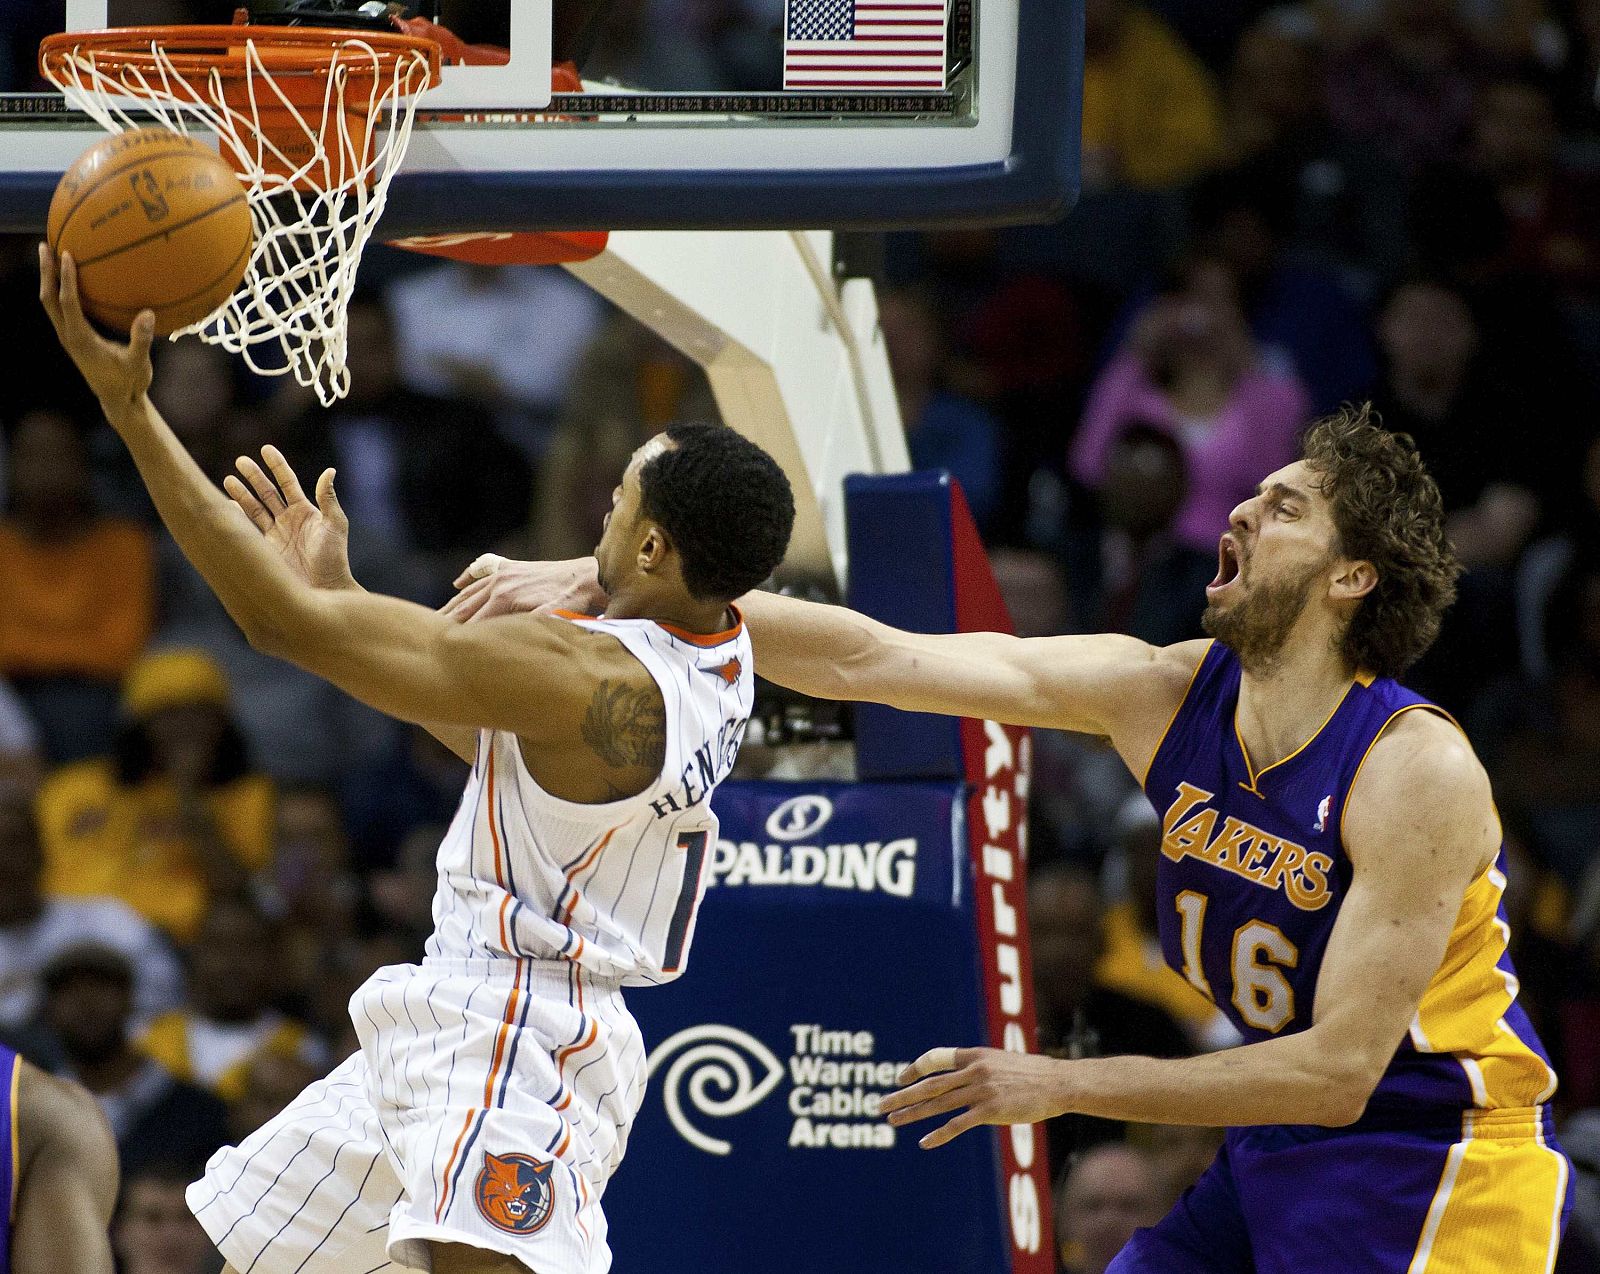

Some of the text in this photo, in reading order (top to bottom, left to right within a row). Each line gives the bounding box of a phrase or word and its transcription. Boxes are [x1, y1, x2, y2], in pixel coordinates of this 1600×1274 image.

[1160, 781, 1334, 911] LAKERS
[706, 837, 918, 898] PALDING
[1175, 889, 1299, 1034] 16
[789, 1023, 875, 1055] Time
[789, 1055, 910, 1087] Warner
[788, 1085, 883, 1118] Cable
[788, 1116, 896, 1148] Arena
